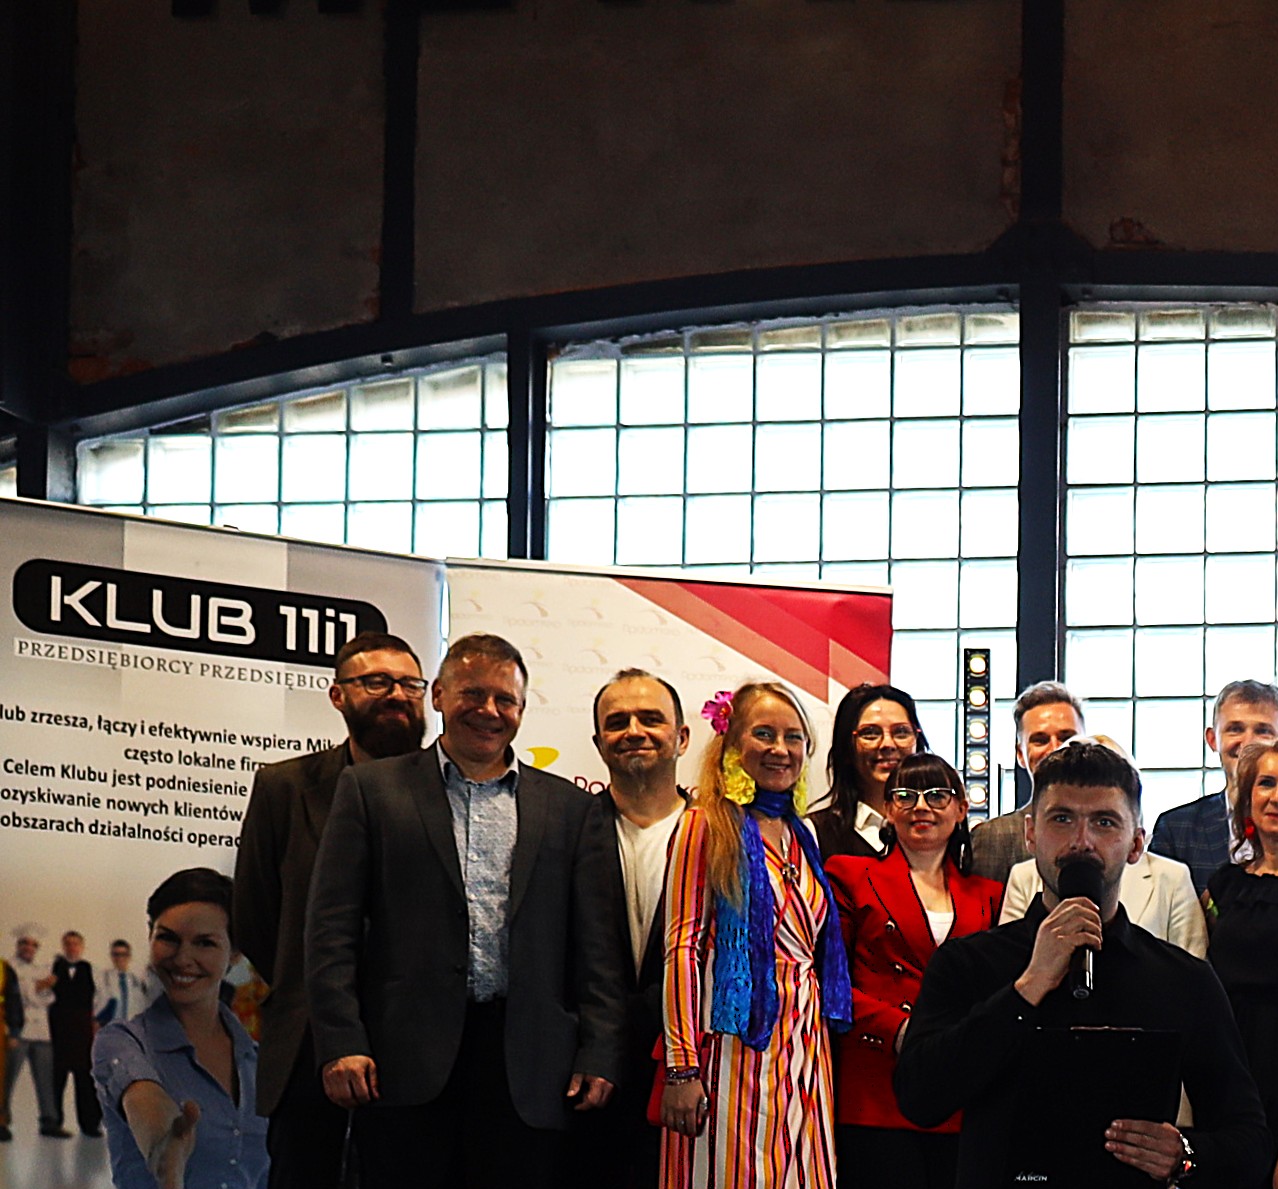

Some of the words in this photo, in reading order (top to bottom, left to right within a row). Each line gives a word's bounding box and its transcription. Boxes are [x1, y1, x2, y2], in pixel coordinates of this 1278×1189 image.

[50, 575, 256, 645] KLUB
[18, 640, 195, 676] PRZEDSIĘBIORCY
[199, 662, 336, 690] PRZEDSIĘBIO
[0, 703, 26, 722] lub
[31, 711, 94, 732] zrzesza,
[97, 714, 137, 737] łączy
[140, 719, 146, 735] i
[148, 722, 237, 745] efektywnie
[241, 734, 301, 751] wspiera
[306, 738, 337, 752] Mik
[3, 758, 56, 778] Celem
[60, 763, 108, 783] Klubu
[111, 768, 141, 788] jest
[146, 774, 248, 797] podniesienie
[124, 747, 174, 764] często
[177, 750, 236, 770] lokalne
[240, 759, 265, 772] fir
[0, 787, 102, 809] ozyskiwanie
[106, 798, 169, 817] nowych
[174, 800, 244, 822] klientów
[0, 811, 85, 834] obszarach
[88, 818, 184, 844] działalności
